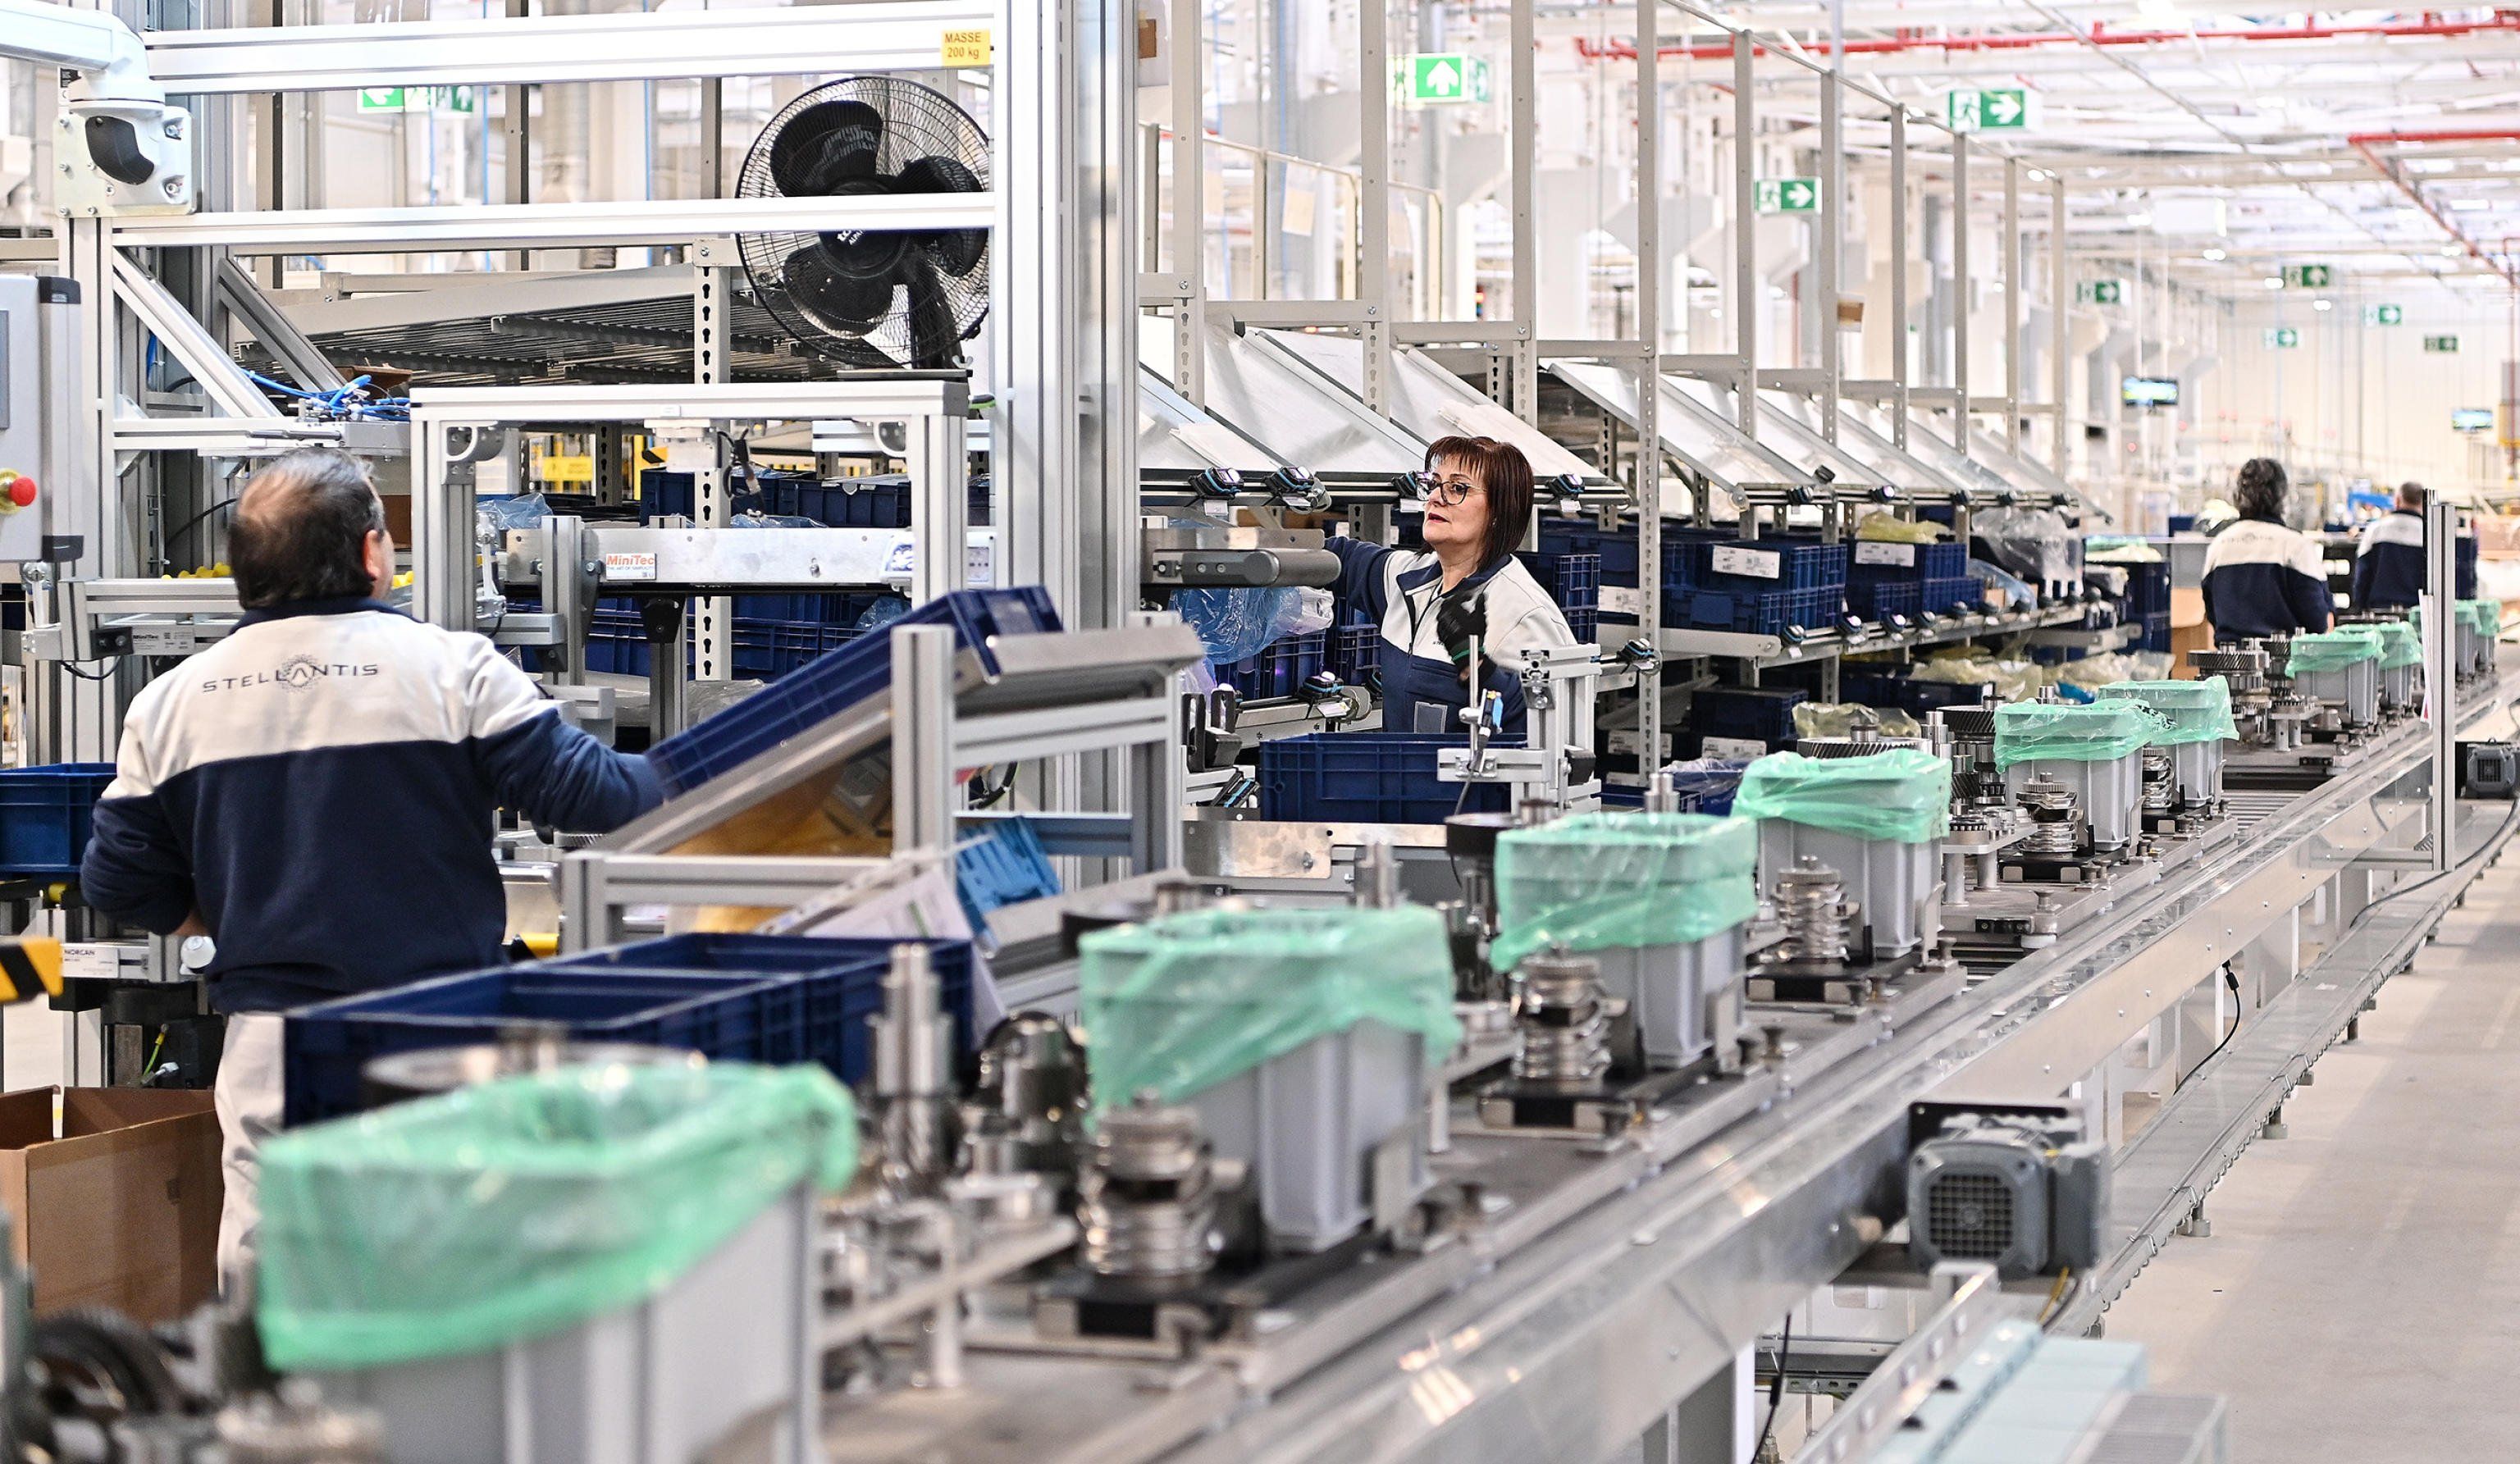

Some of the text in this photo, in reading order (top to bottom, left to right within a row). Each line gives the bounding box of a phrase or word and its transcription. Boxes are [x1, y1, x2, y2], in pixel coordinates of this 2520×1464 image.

[945, 32, 981, 43] MASSE
[947, 47, 979, 59] 200 kg
[607, 554, 655, 565] MiniTec
[203, 663, 379, 692] STELLANTIS
